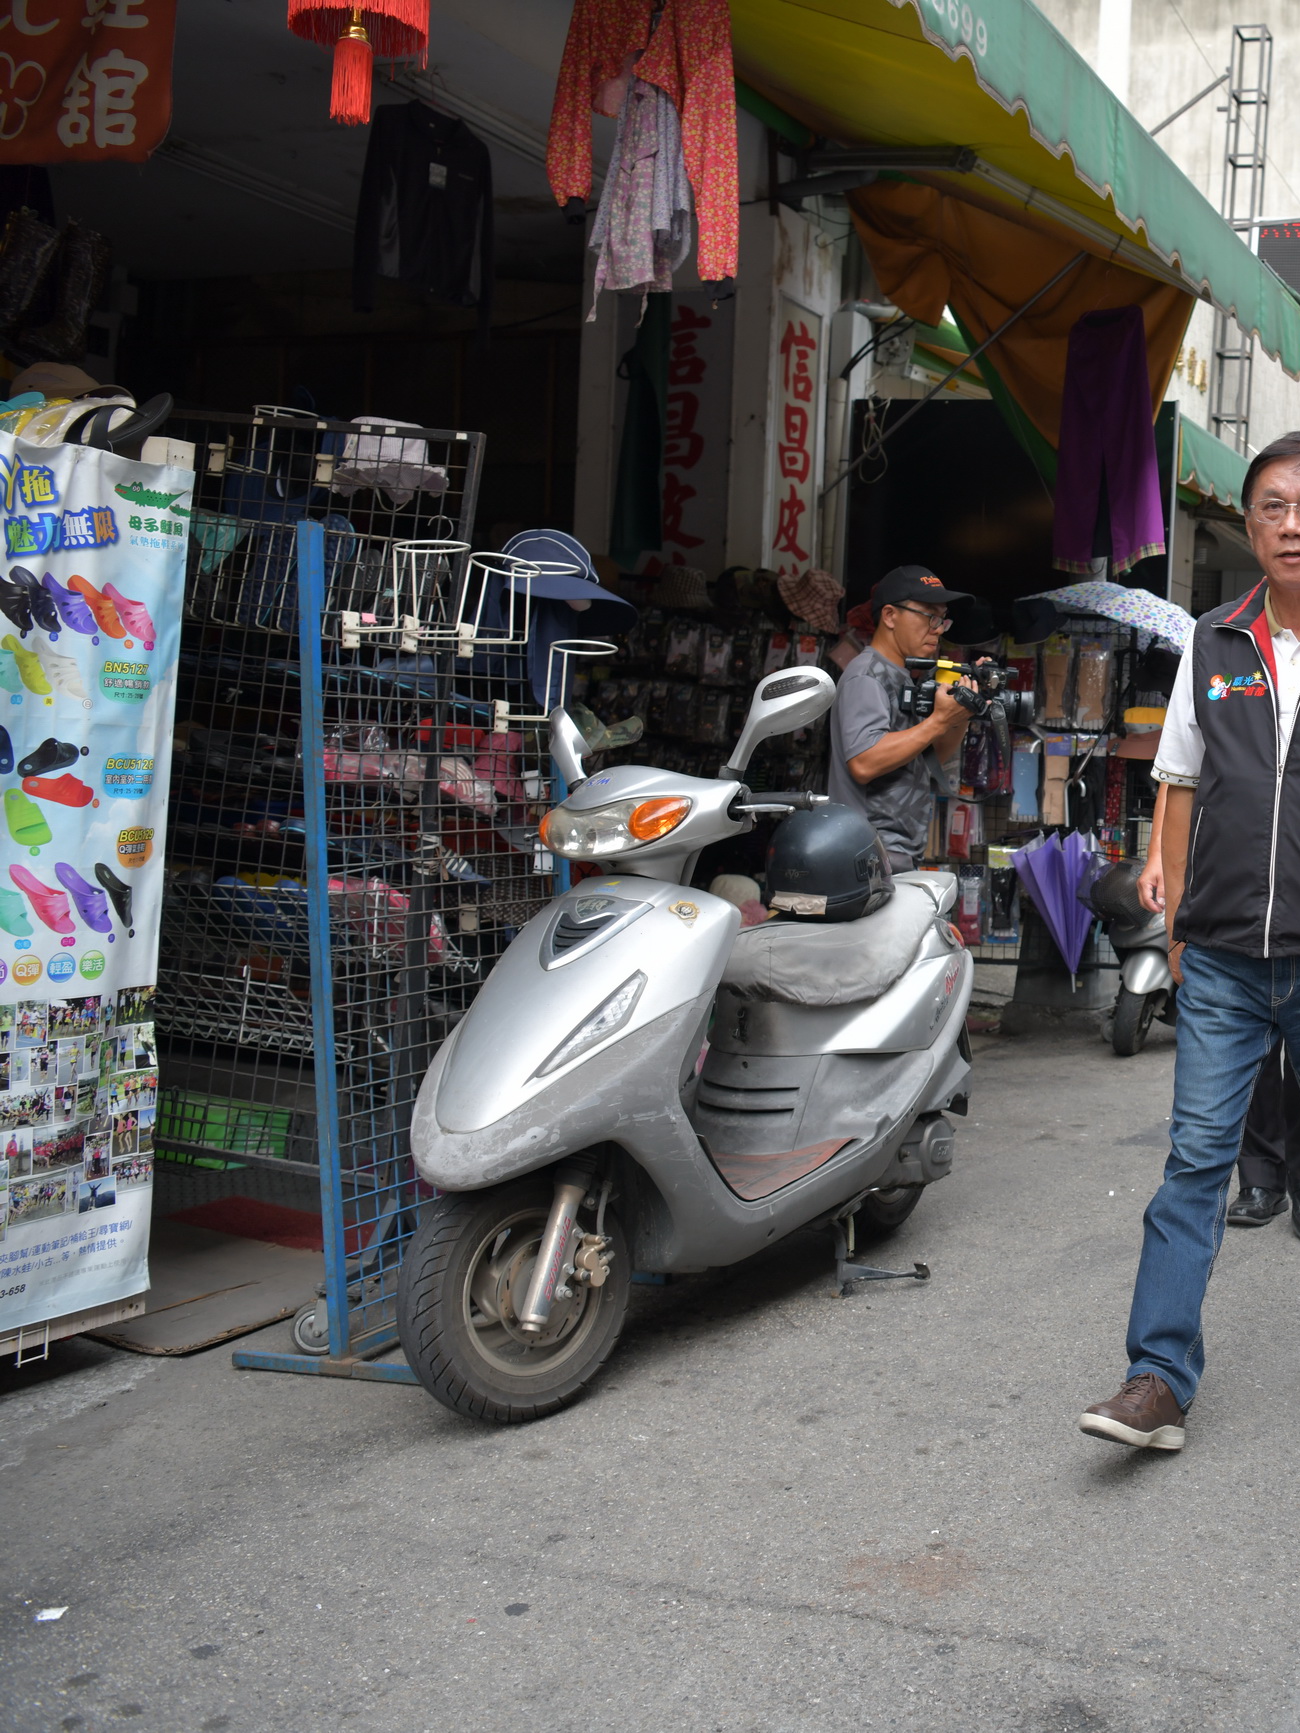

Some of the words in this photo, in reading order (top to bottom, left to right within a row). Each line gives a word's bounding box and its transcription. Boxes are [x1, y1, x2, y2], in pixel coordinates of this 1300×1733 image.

[772, 320, 818, 576] 信昌皮
[7, 509, 117, 555] 魅力無限
[103, 661, 150, 675] BN5127
[16, 963, 40, 977] Q彈
[49, 961, 74, 976] 輕盈
[81, 959, 103, 972] 樂活
